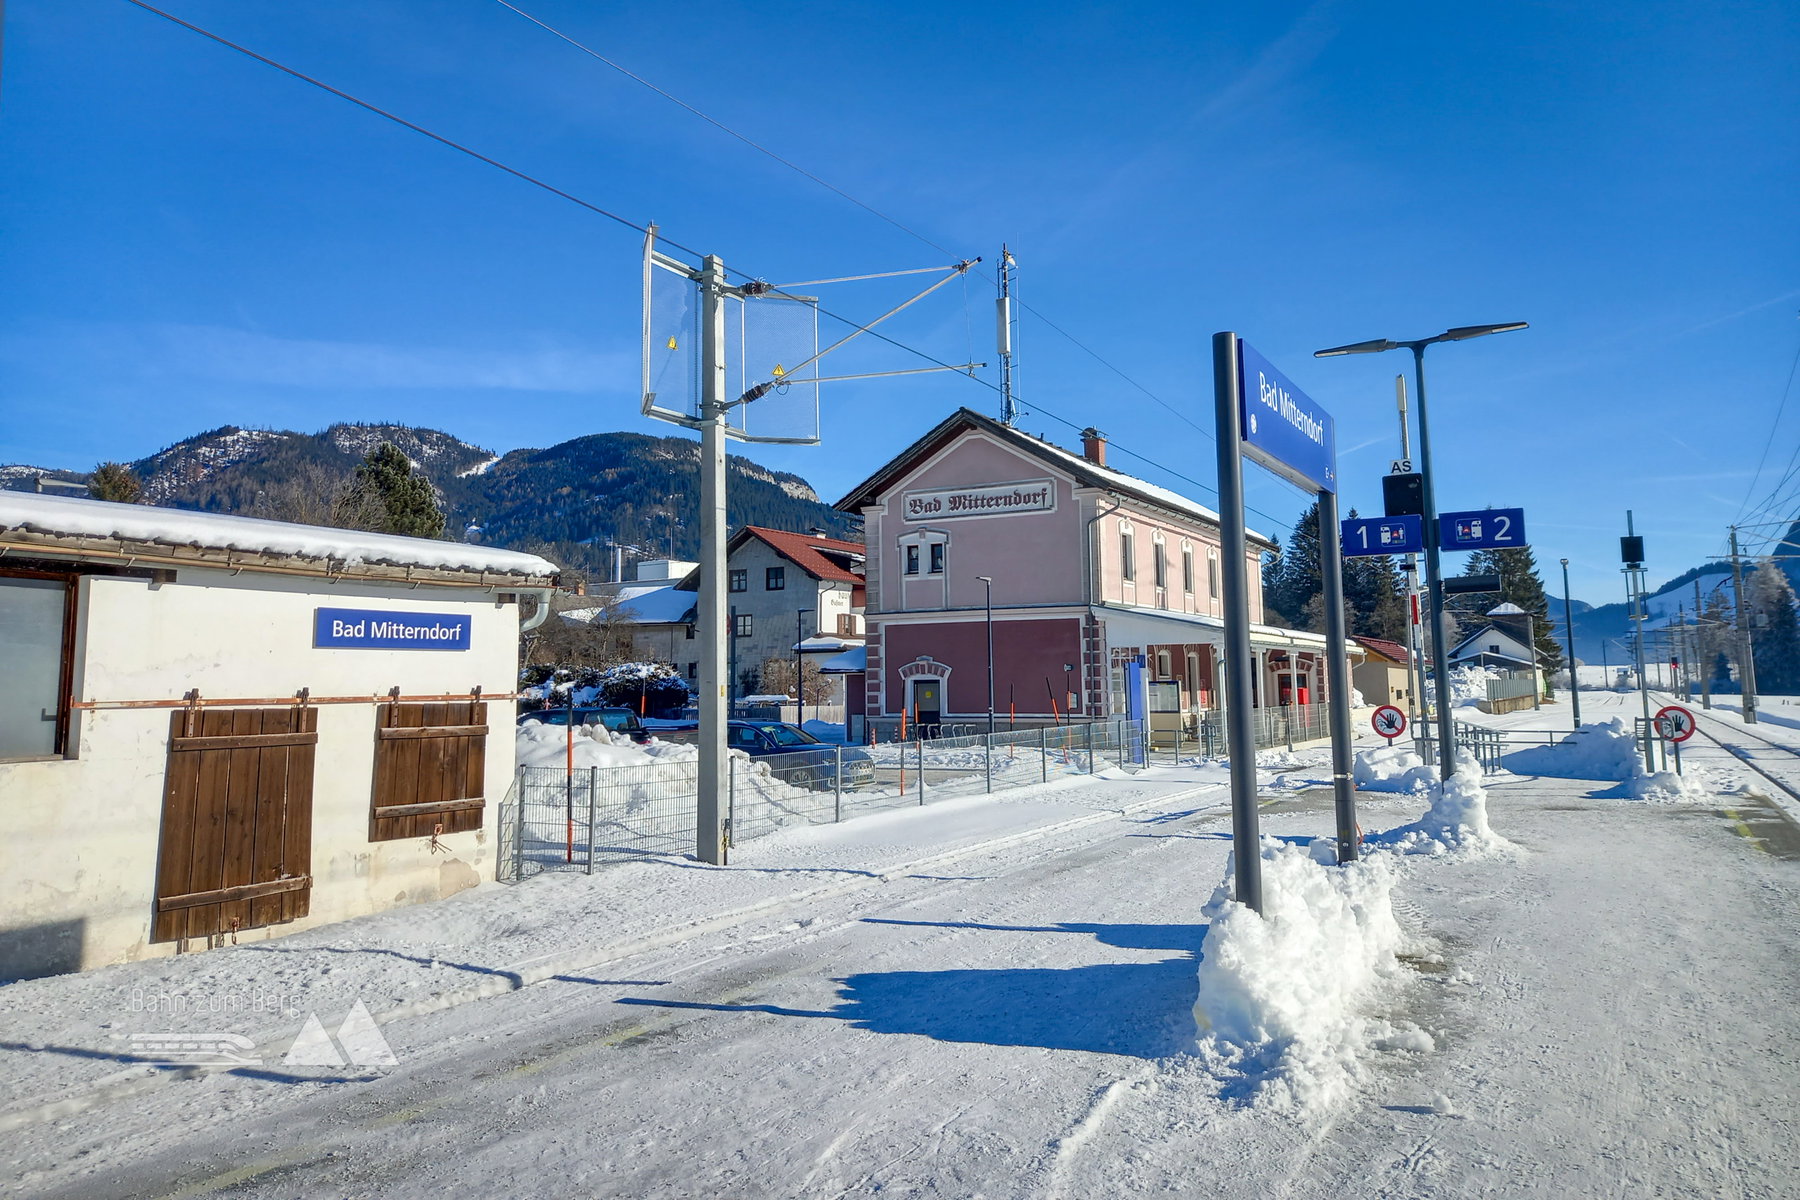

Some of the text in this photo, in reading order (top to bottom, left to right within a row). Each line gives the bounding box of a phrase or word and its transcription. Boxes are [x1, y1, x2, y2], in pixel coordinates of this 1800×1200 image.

[1259, 371, 1324, 447] Bad Mitterndorf
[1391, 460, 1412, 474] AS
[909, 488, 1048, 515] Bad Mitterndorf
[1356, 525, 1368, 549] 1
[1493, 516, 1512, 541] 2
[332, 619, 462, 641] Bad Mitterndorf
